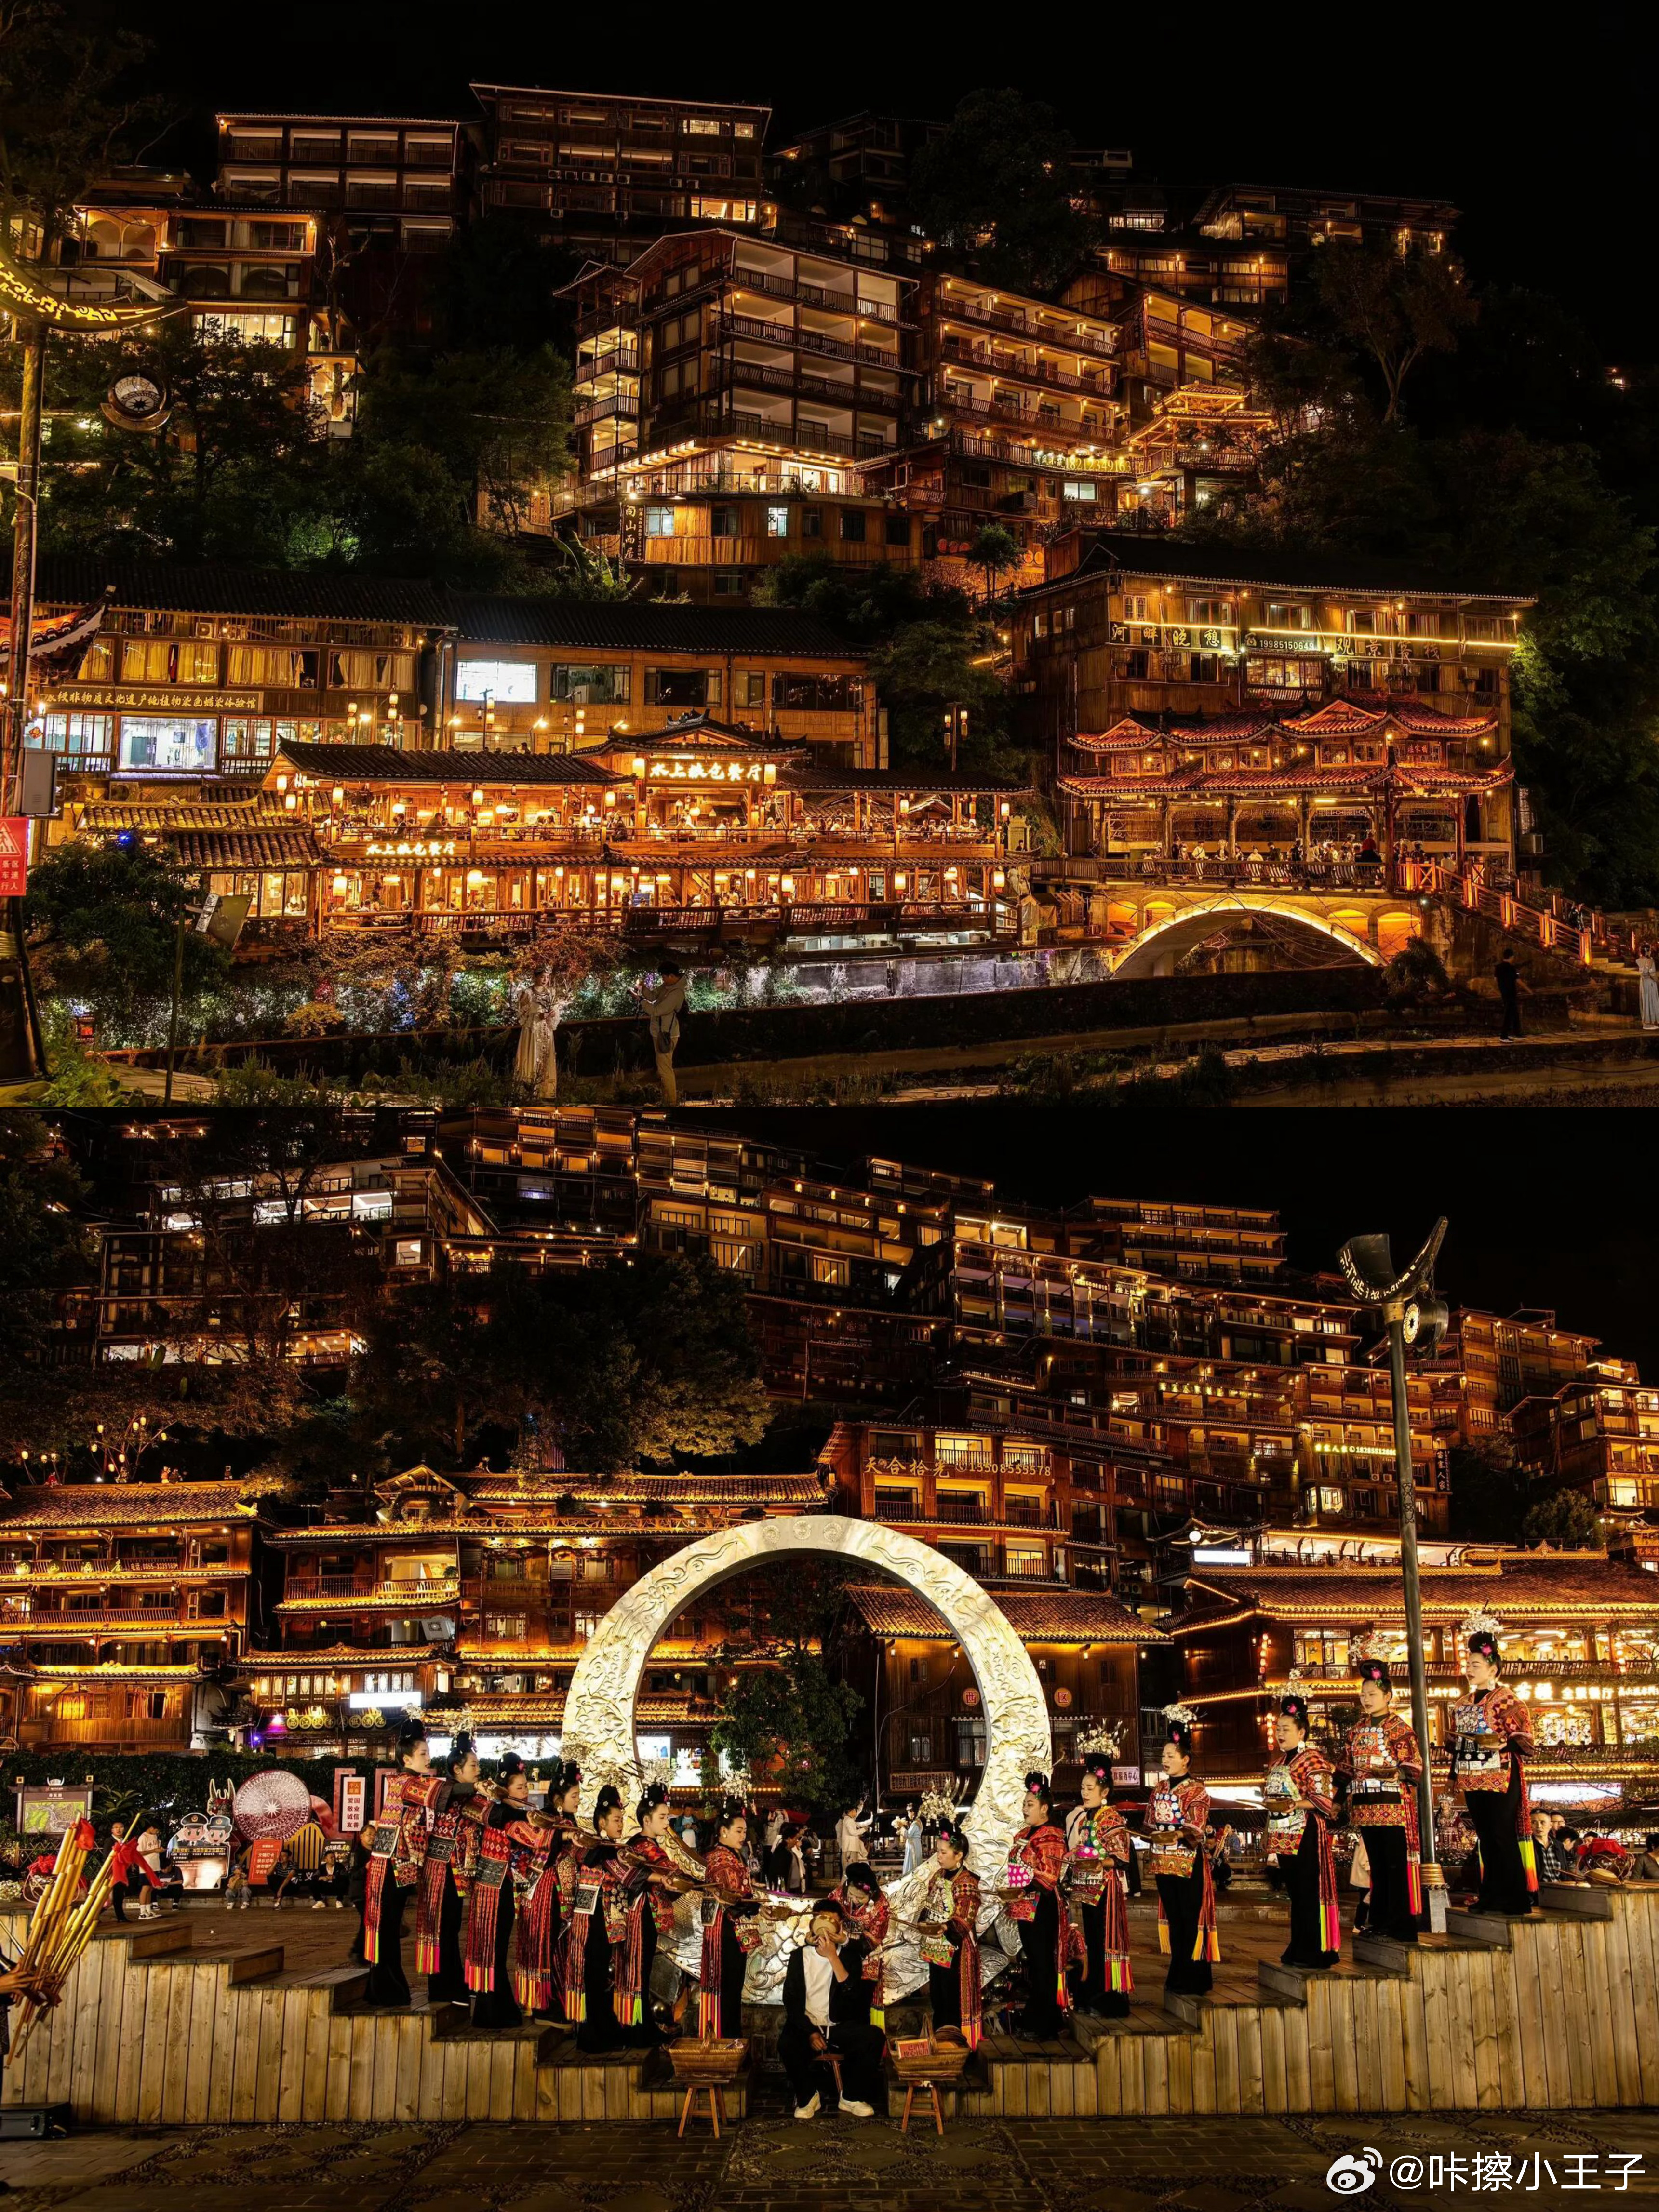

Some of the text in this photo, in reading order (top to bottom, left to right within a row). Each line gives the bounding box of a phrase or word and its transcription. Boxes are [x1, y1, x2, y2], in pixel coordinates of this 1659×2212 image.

[1066, 457, 1131, 472] 18212349163
[1111, 624, 1220, 647] 河畔晚憩
[1259, 640, 1315, 650] 19985150649
[864, 1456, 1051, 1478] 天合拾光 15508555578
